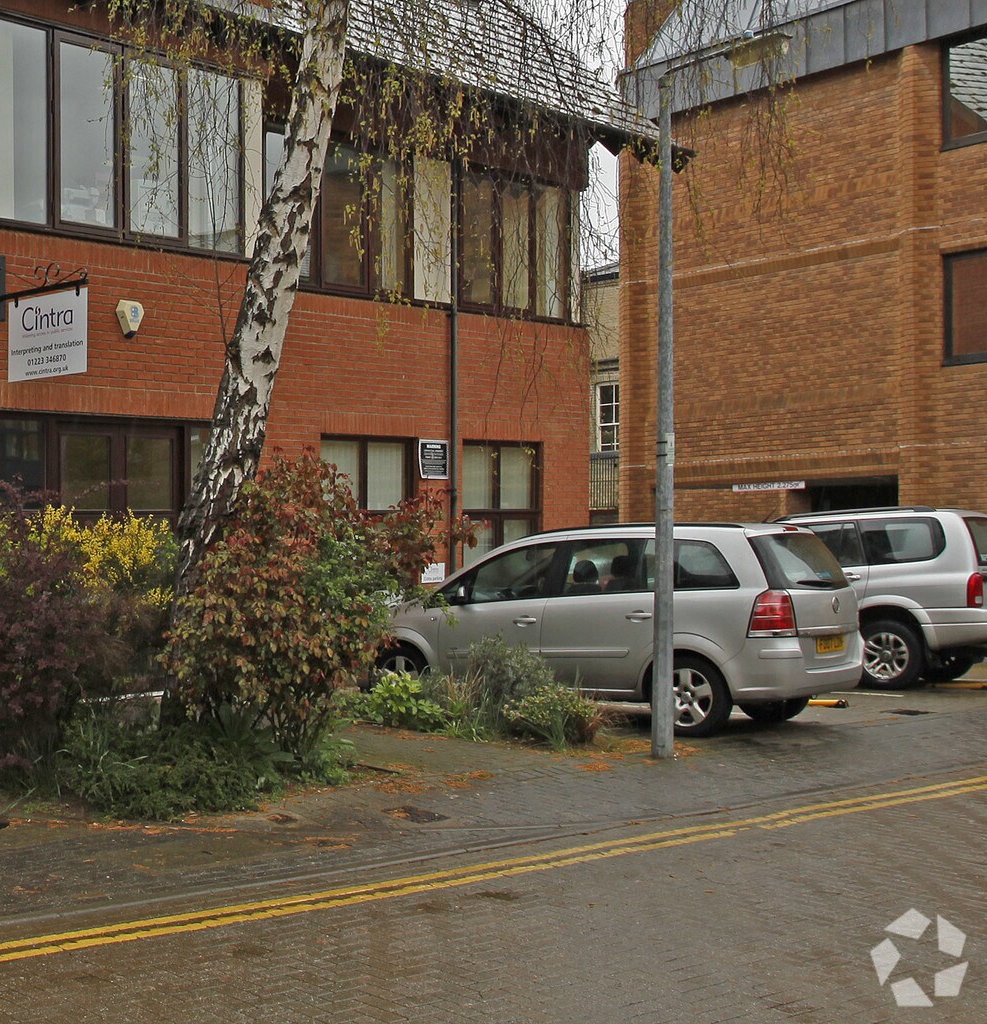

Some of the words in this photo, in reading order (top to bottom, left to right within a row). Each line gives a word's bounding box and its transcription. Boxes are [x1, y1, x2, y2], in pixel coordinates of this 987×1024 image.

[22, 306, 73, 332] Cintra
[11, 345, 42, 357] Interpreting
[42, 343, 53, 351] and
[54, 339, 84, 350] translation
[27, 357, 44, 366] 01223
[45, 353, 67, 364] 346870
[25, 365, 69, 376] www.cintra.org.uk
[753, 482, 776, 490] HEIGHT
